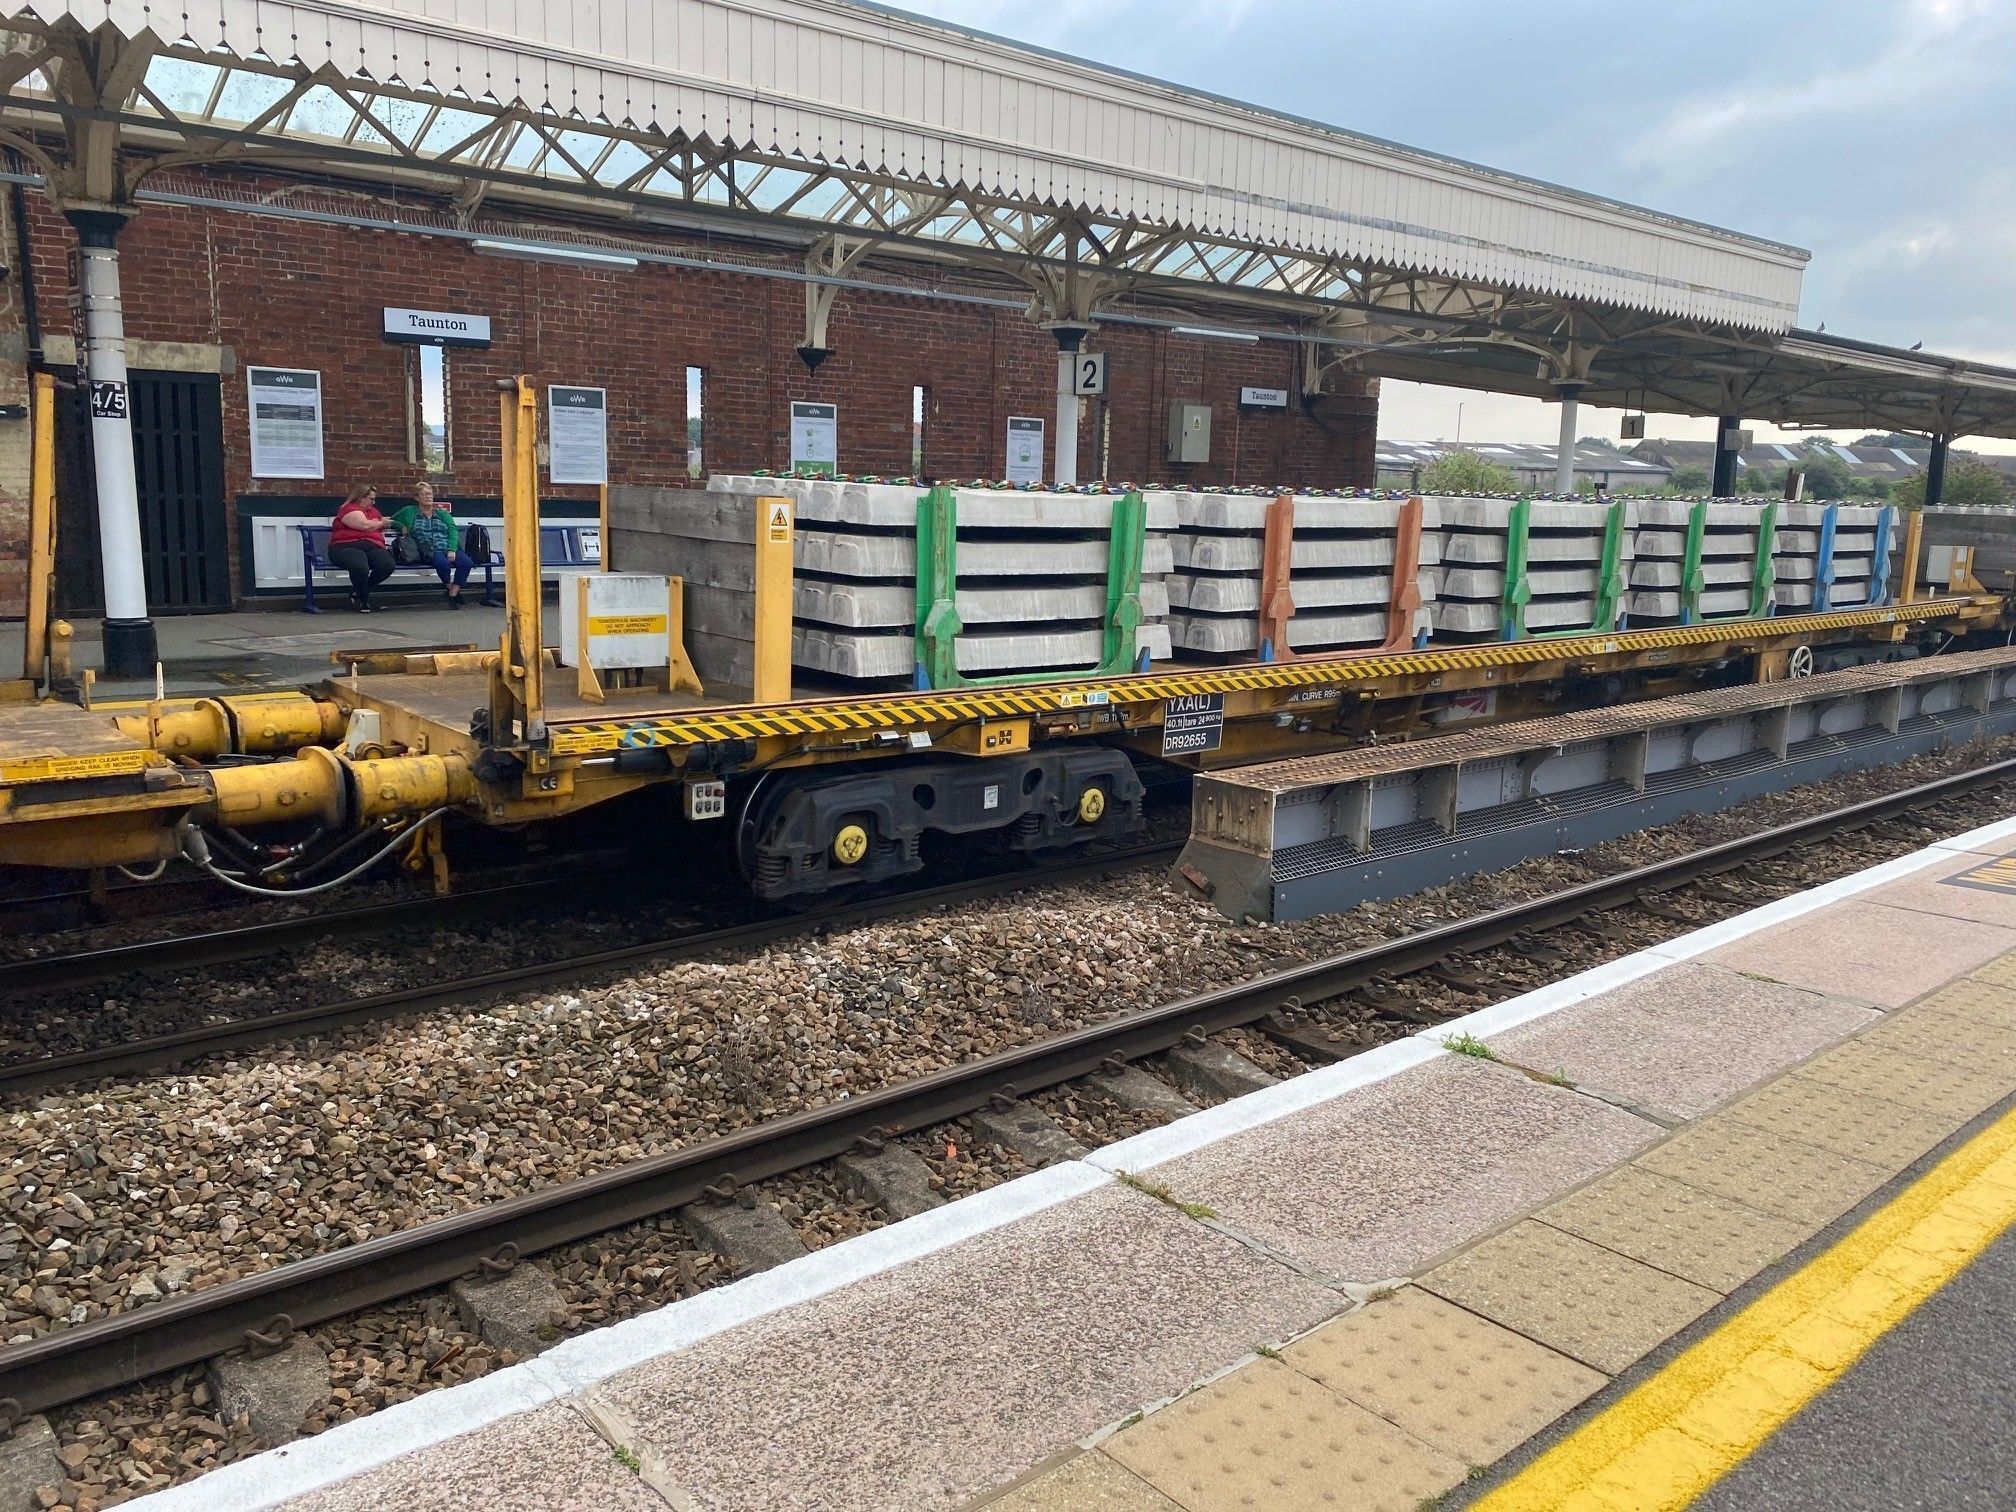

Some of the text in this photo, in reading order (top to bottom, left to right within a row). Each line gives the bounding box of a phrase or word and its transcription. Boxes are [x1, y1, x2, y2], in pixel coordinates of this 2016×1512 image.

[409, 315, 467, 331] Taunton
[1083, 360, 1097, 388] 2
[92, 391, 125, 410] 4/5
[1252, 391, 1277, 401] Taunton
[1630, 420, 1635, 435] 1
[1302, 690, 1323, 701] CURVE
[1165, 732, 1207, 750] DR92655
